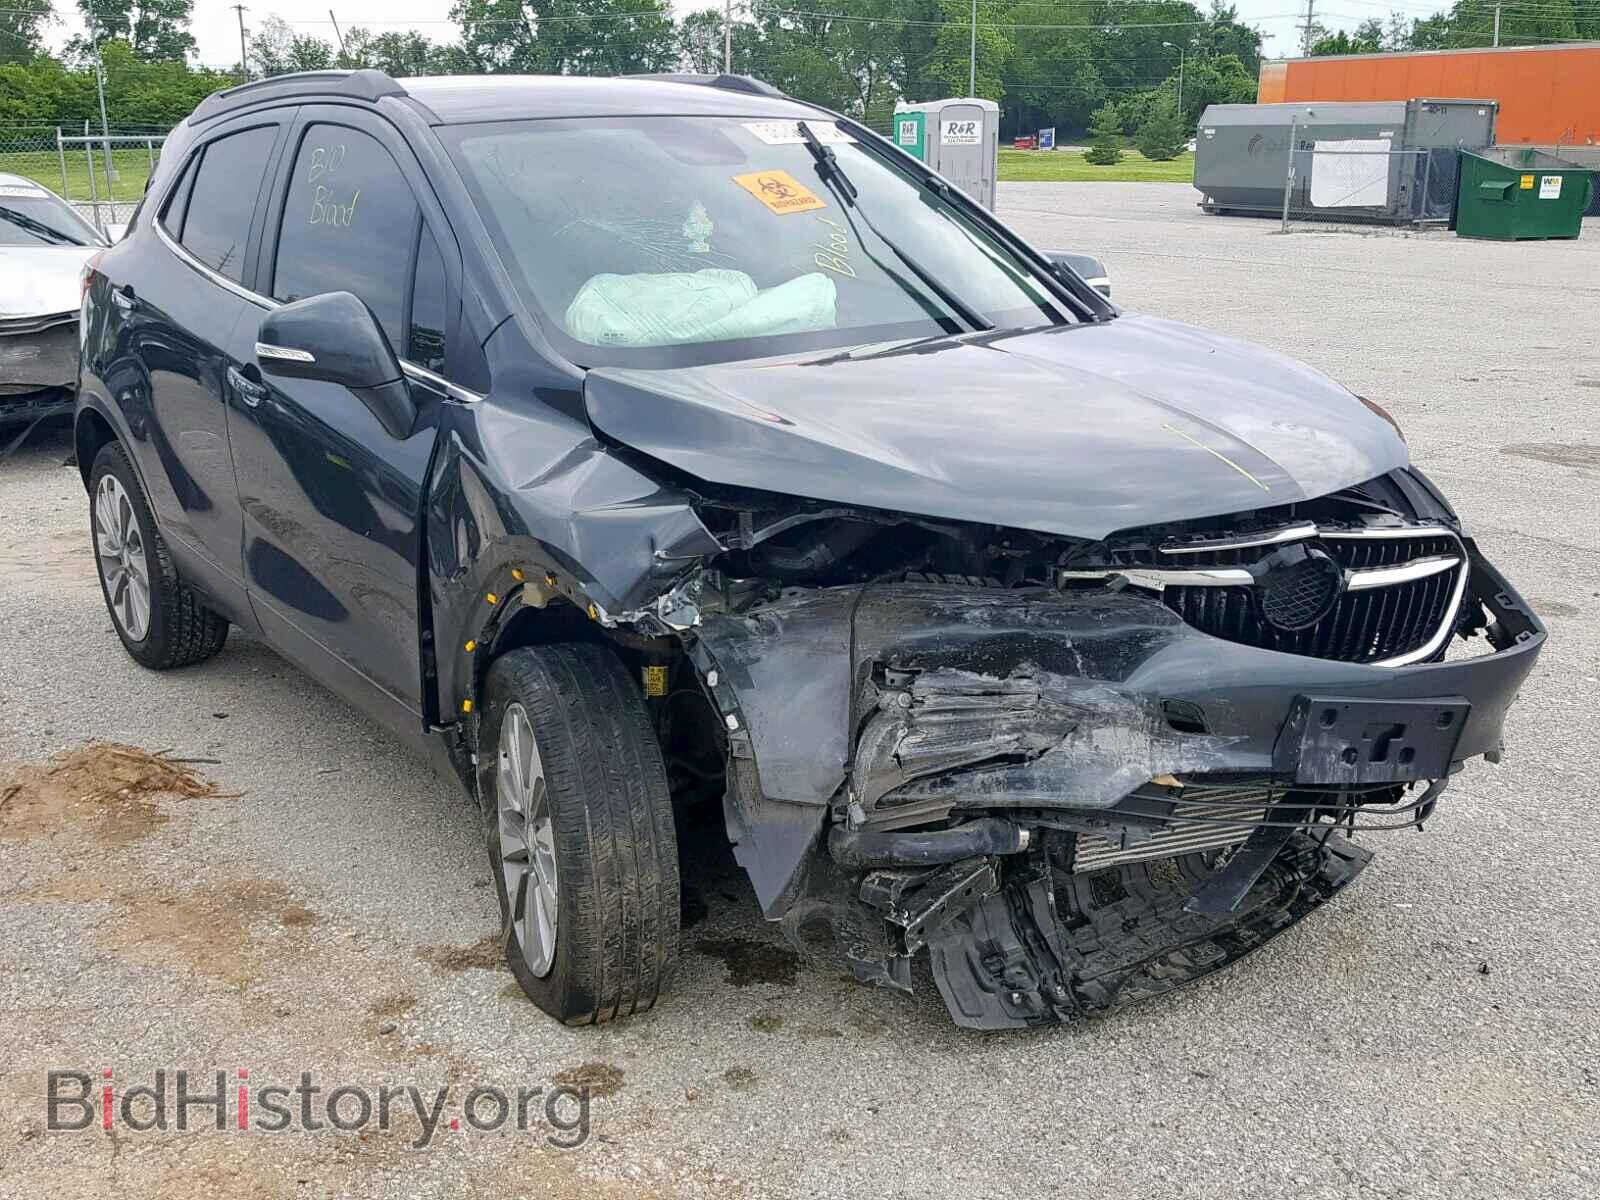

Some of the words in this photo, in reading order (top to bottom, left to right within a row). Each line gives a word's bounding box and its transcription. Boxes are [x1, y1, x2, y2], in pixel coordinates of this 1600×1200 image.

[947, 122, 976, 135] R&R
[769, 196, 817, 209] BIOHAZARD
[815, 216, 856, 279] Blood
